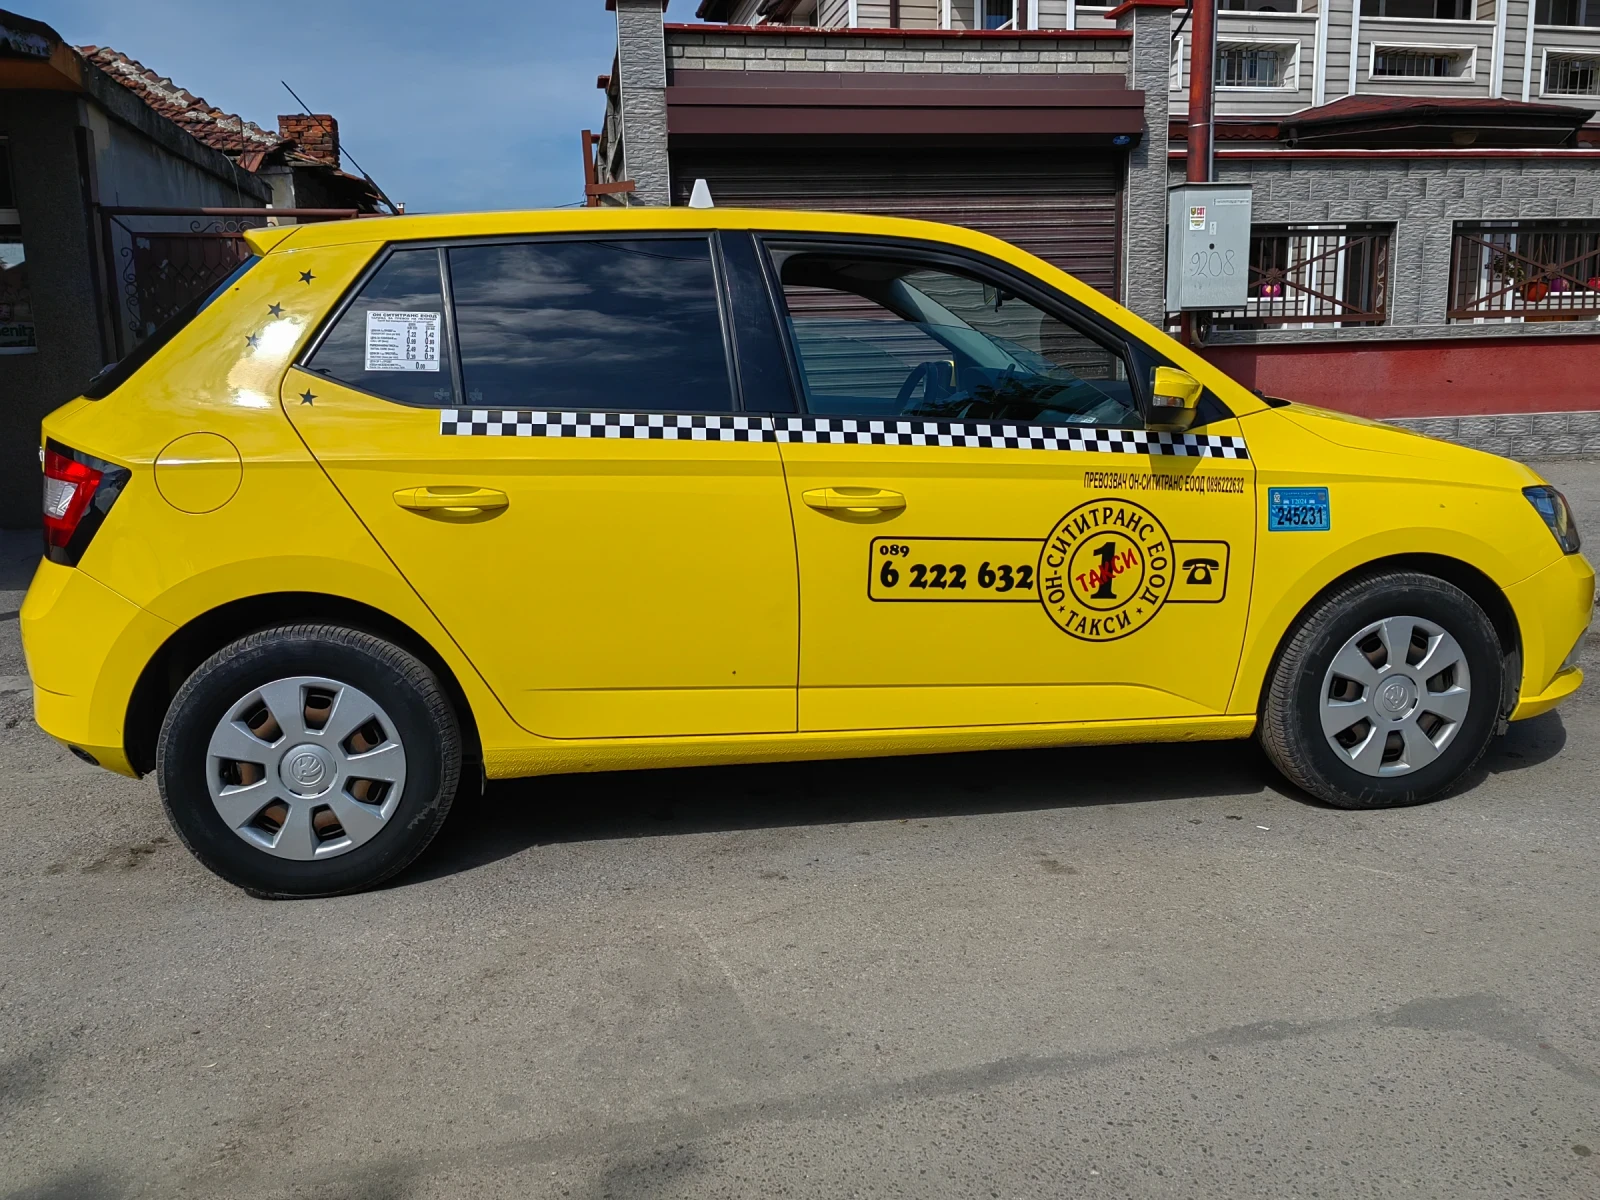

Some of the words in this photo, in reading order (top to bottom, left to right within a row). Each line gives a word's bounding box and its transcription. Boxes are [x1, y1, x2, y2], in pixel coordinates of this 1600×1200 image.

[1191, 249, 1235, 278] 9208
[1083, 471, 1127, 489] ПРЕВОЗВАЧ
[1129, 473, 1184, 492] ОН-СИТИТРАНС
[1185, 475, 1205, 495] ЕООД
[1206, 476, 1245, 494] 0896222632
[1277, 506, 1323, 526] 245231
[879, 544, 910, 558] 089
[1045, 507, 1155, 605] ОН-СИТИТРАНС
[1138, 541, 1168, 606] ЕООД
[880, 560, 900, 588] 6
[908, 563, 967, 590] 222
[977, 561, 1034, 593] 632
[1075, 547, 1139, 593] ТАКСИ
[1090, 541, 1118, 600] 1
[1064, 609, 1132, 636] ТАКСИ
